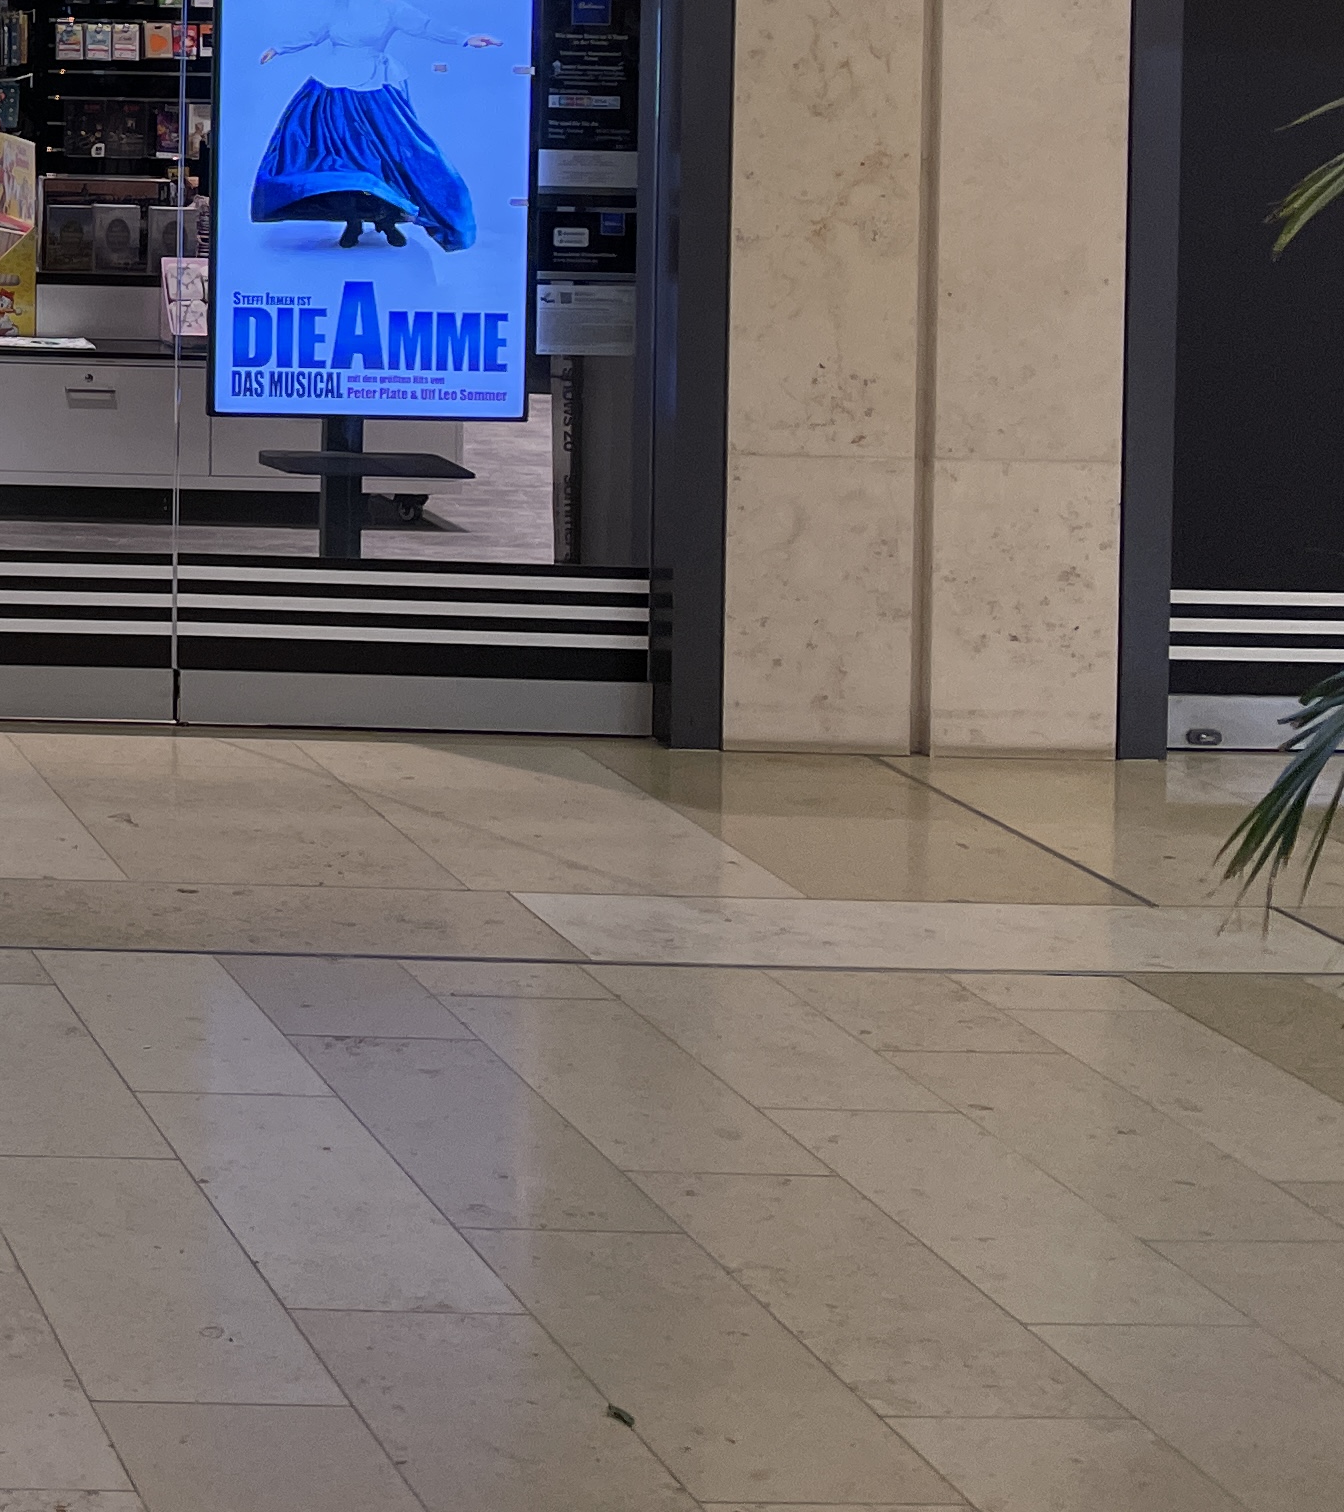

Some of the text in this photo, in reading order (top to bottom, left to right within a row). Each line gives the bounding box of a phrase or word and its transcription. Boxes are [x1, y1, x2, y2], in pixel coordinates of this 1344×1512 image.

[232, 307, 328, 369] DIE
[330, 280, 510, 373] AMME
[231, 370, 343, 399] DAS MUSICAL
[362, 375, 378, 384] den
[430, 377, 445, 385] von
[347, 387, 377, 400] Peter
[379, 388, 408, 400] Plate
[410, 390, 418, 400] &
[438, 388, 457, 401] Leo
[460, 389, 507, 401] Sommer
